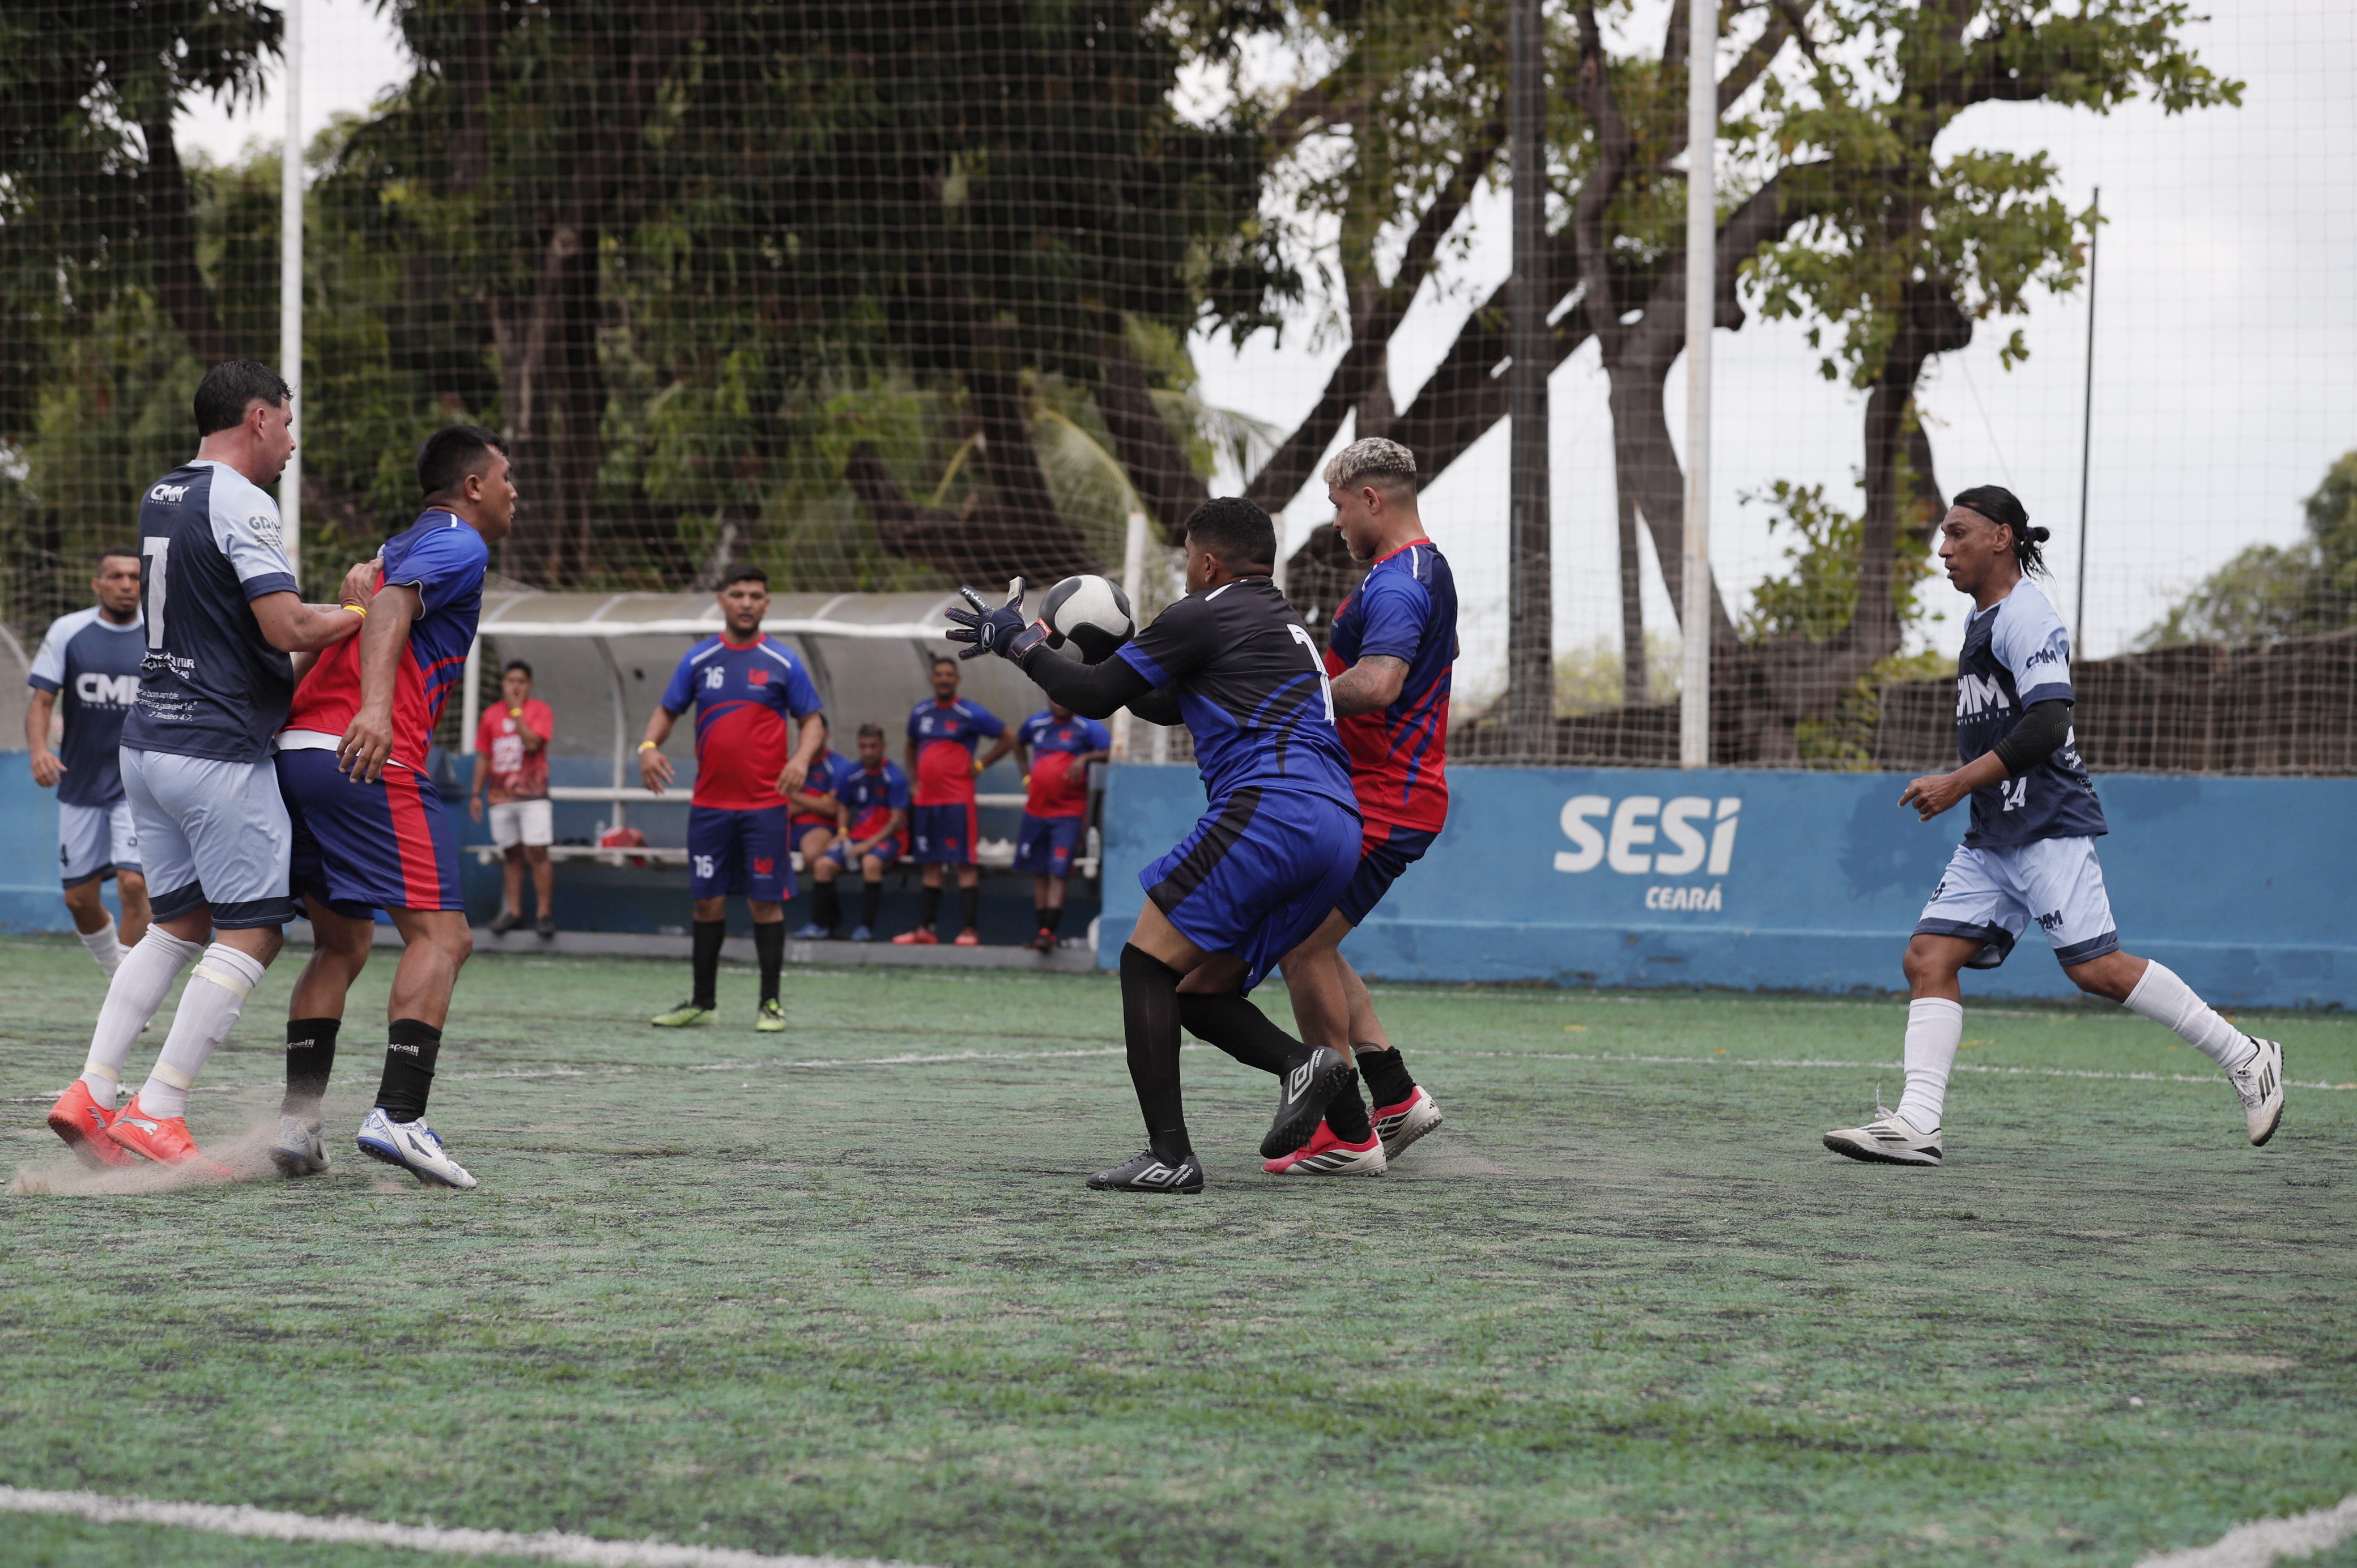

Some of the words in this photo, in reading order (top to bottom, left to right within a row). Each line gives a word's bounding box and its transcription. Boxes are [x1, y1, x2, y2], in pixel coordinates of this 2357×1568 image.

[150, 484, 190, 502] CMM
[142, 536, 170, 649] 7
[704, 666, 725, 689] 16
[1956, 673, 2010, 717] MM
[2001, 777, 2027, 811] 24
[693, 854, 714, 879] 16
[1644, 882, 1722, 912] CEARÁ
[1315, 1049, 1325, 1067] umbro
[1175, 1168, 1194, 1186] umbro
